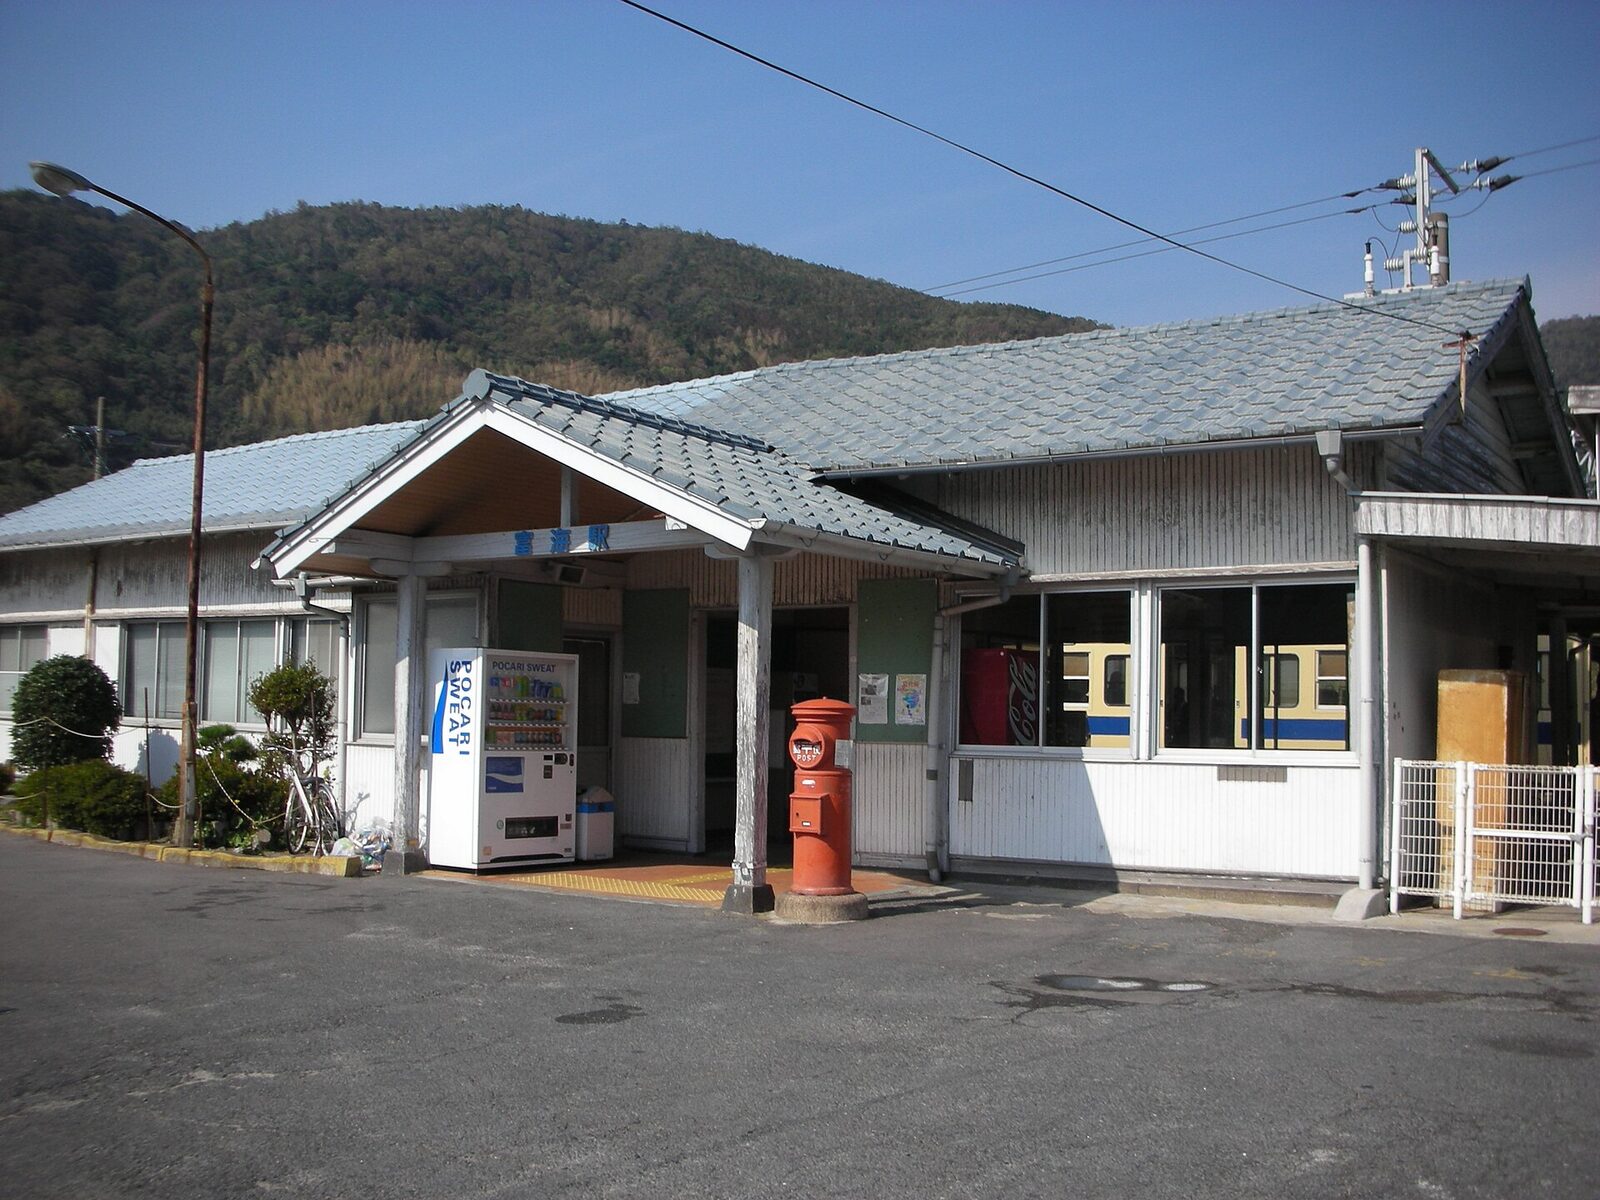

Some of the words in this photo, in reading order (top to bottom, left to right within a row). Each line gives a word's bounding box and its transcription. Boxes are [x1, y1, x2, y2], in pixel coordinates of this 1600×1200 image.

[448, 660, 461, 747] SWEAT
[459, 660, 472, 755] POCARI
[492, 661, 525, 672] POCARI
[526, 663, 556, 673] SWEAT
[1009, 654, 1036, 747] Cola
[796, 754, 817, 762] POST
